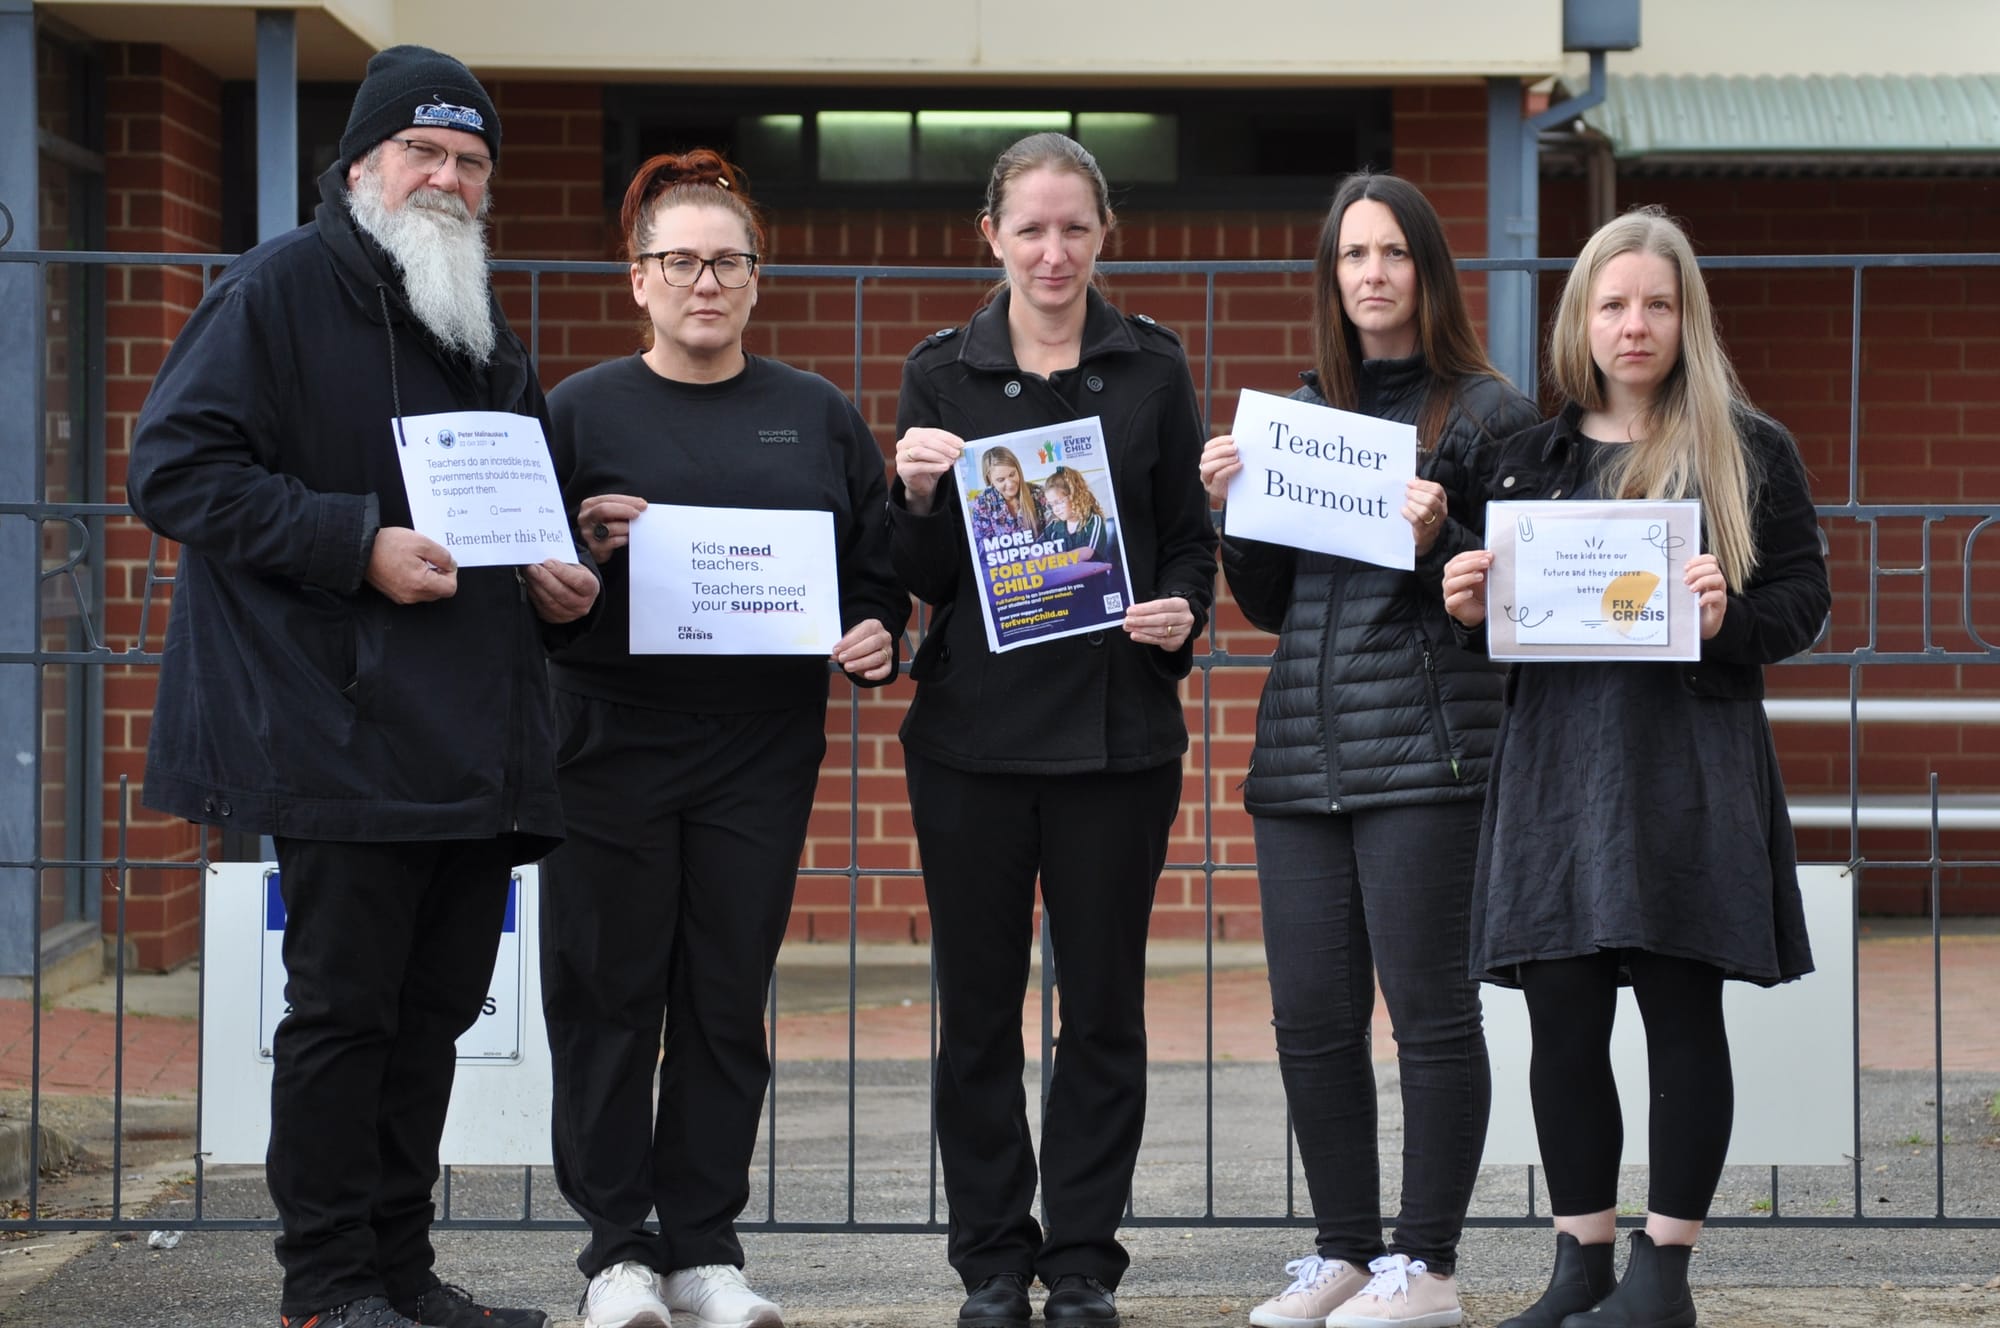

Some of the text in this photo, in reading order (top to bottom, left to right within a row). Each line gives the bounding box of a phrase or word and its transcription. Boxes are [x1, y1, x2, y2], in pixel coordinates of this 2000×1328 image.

[1064, 436, 1091, 447] EVERY
[1065, 443, 1092, 453] CHILD
[1269, 421, 1387, 471] Teacher
[427, 458, 466, 468] Teachers
[468, 457, 478, 466] do
[480, 458, 489, 466] an
[490, 457, 522, 466] incredible
[430, 472, 483, 484] governments
[485, 471, 509, 480] should
[510, 472, 519, 480] do
[432, 486, 498, 497] to support them.
[1264, 468, 1389, 519] Burnout
[445, 530, 511, 546] Remember
[515, 529, 537, 543] this
[983, 530, 1034, 552] MORE
[692, 542, 771, 556] Kids need
[986, 538, 1065, 567] SUPPORT
[1556, 551, 1578, 560] These
[1580, 551, 1596, 560] kids
[1599, 552, 1611, 560] are
[692, 558, 763, 572] teachers.
[989, 551, 1080, 582] FOR EVERY
[1543, 568, 1641, 578] future and they deserve
[692, 582, 806, 597] Teachers need
[992, 574, 1044, 596] CHILD
[692, 599, 804, 614] your support.
[1612, 599, 1634, 609] FIX
[1001, 609, 1069, 630] ForEveryChild.au
[1612, 610, 1665, 621] CRISIS
[678, 625, 692, 633] FIX
[678, 632, 713, 640] CRISIS
